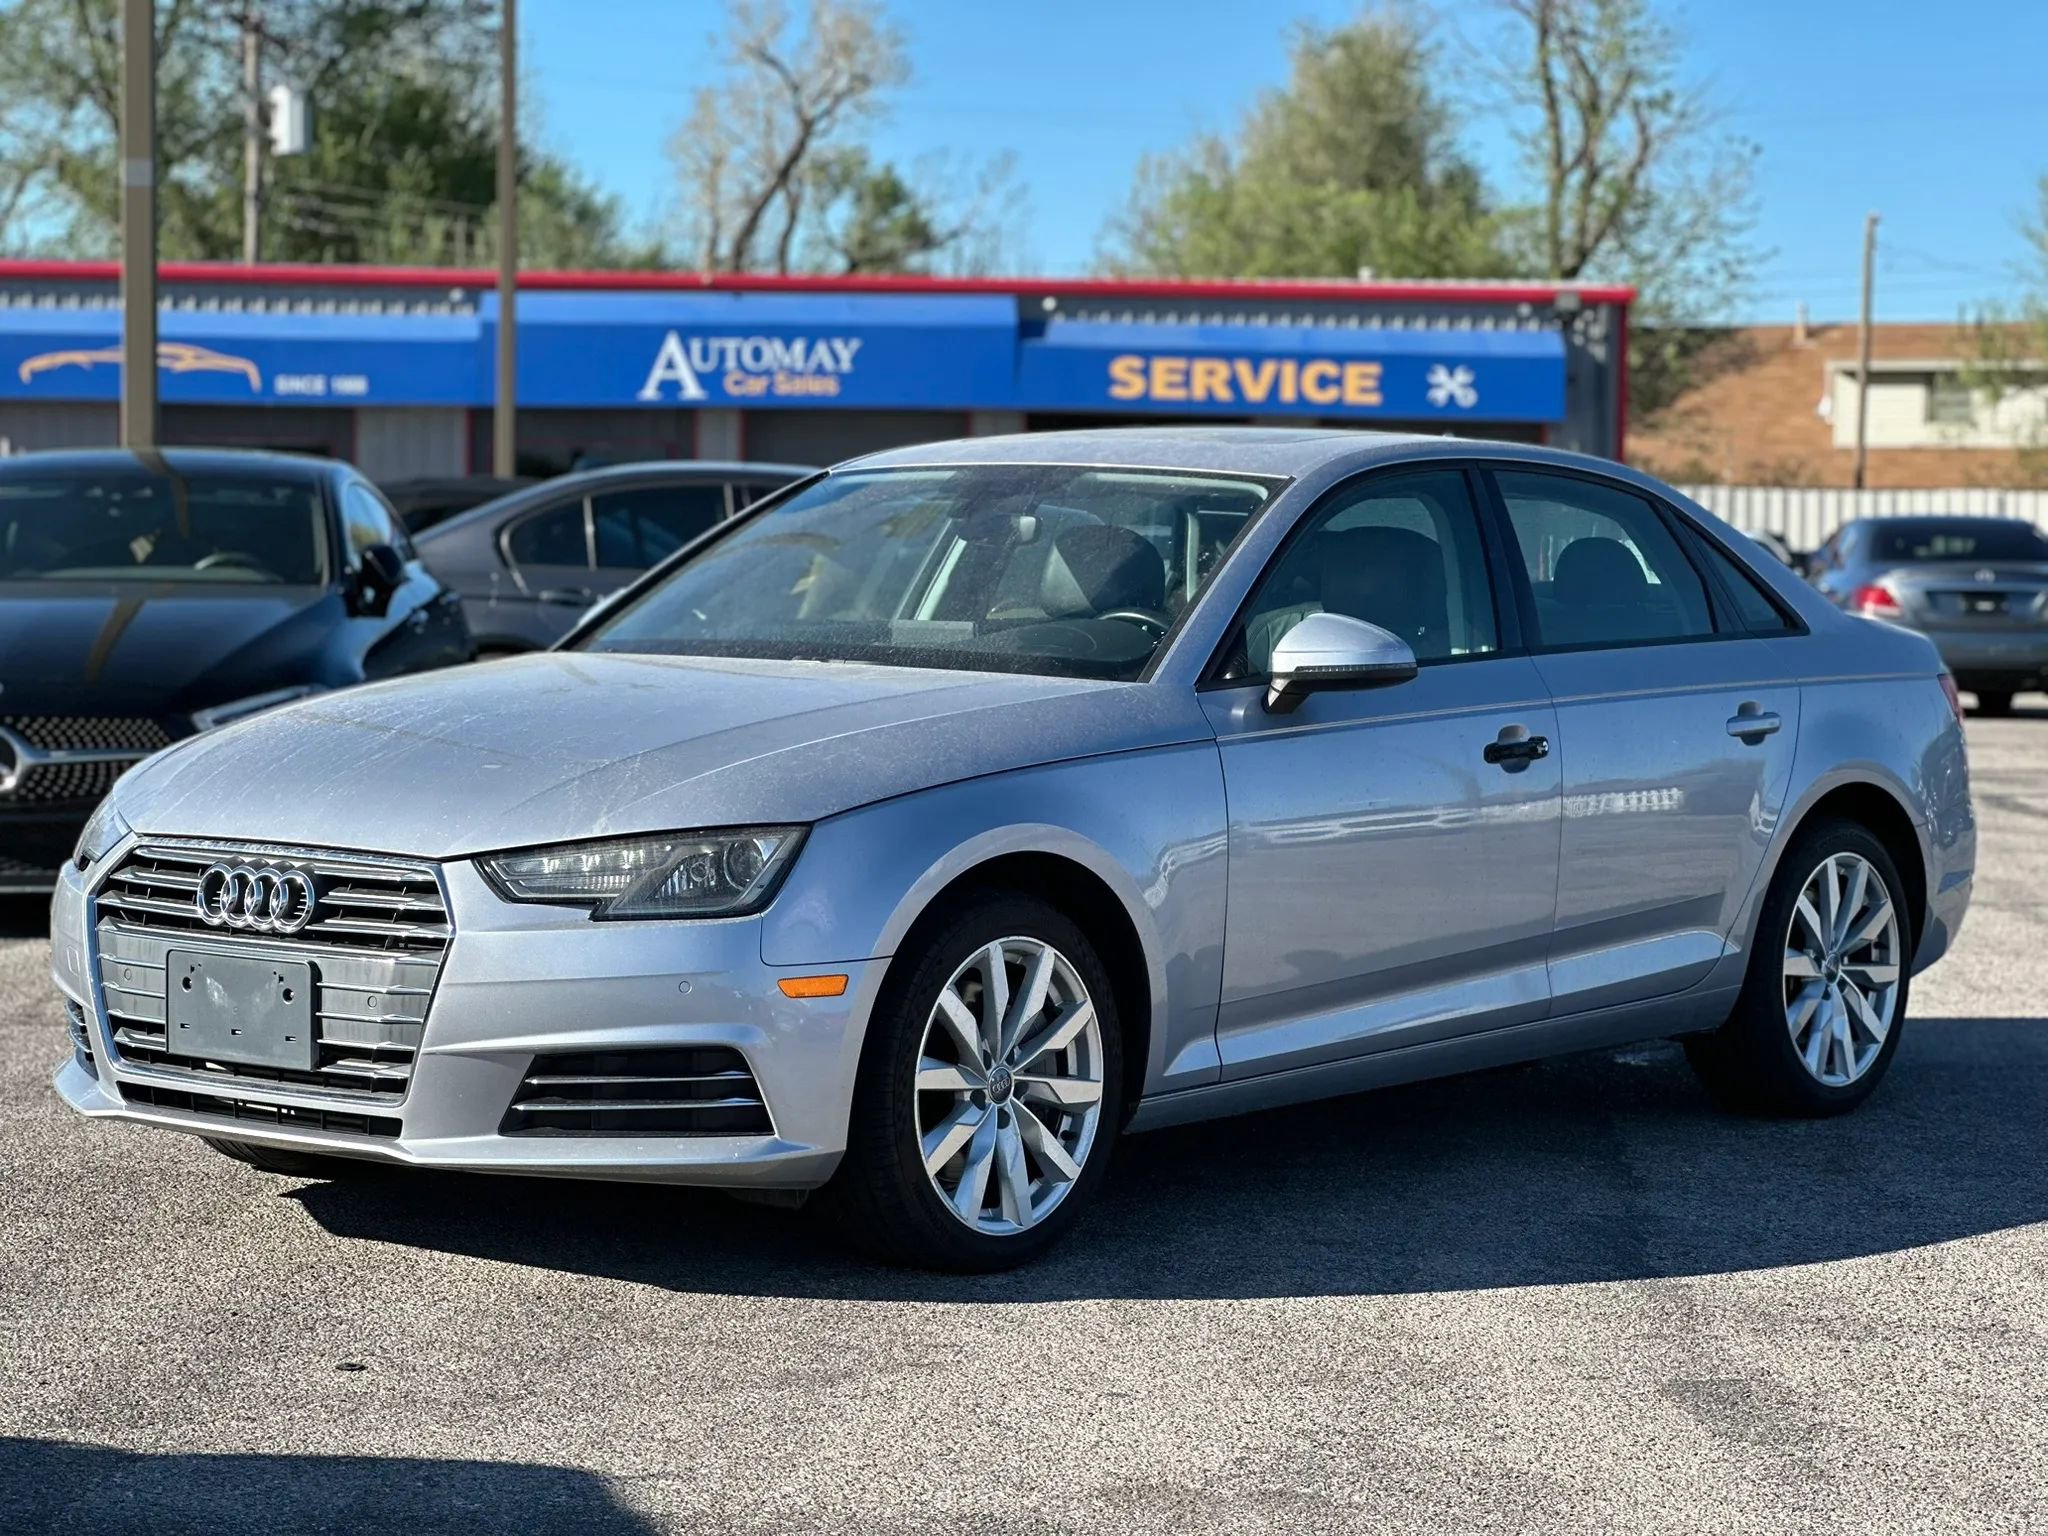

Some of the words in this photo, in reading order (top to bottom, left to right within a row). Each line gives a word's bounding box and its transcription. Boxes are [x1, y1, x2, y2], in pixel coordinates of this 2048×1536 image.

[638, 330, 861, 401] AUTOMAY
[723, 371, 769, 397] Car
[773, 373, 841, 396] Sales
[1108, 354, 1383, 406] SERVICE
